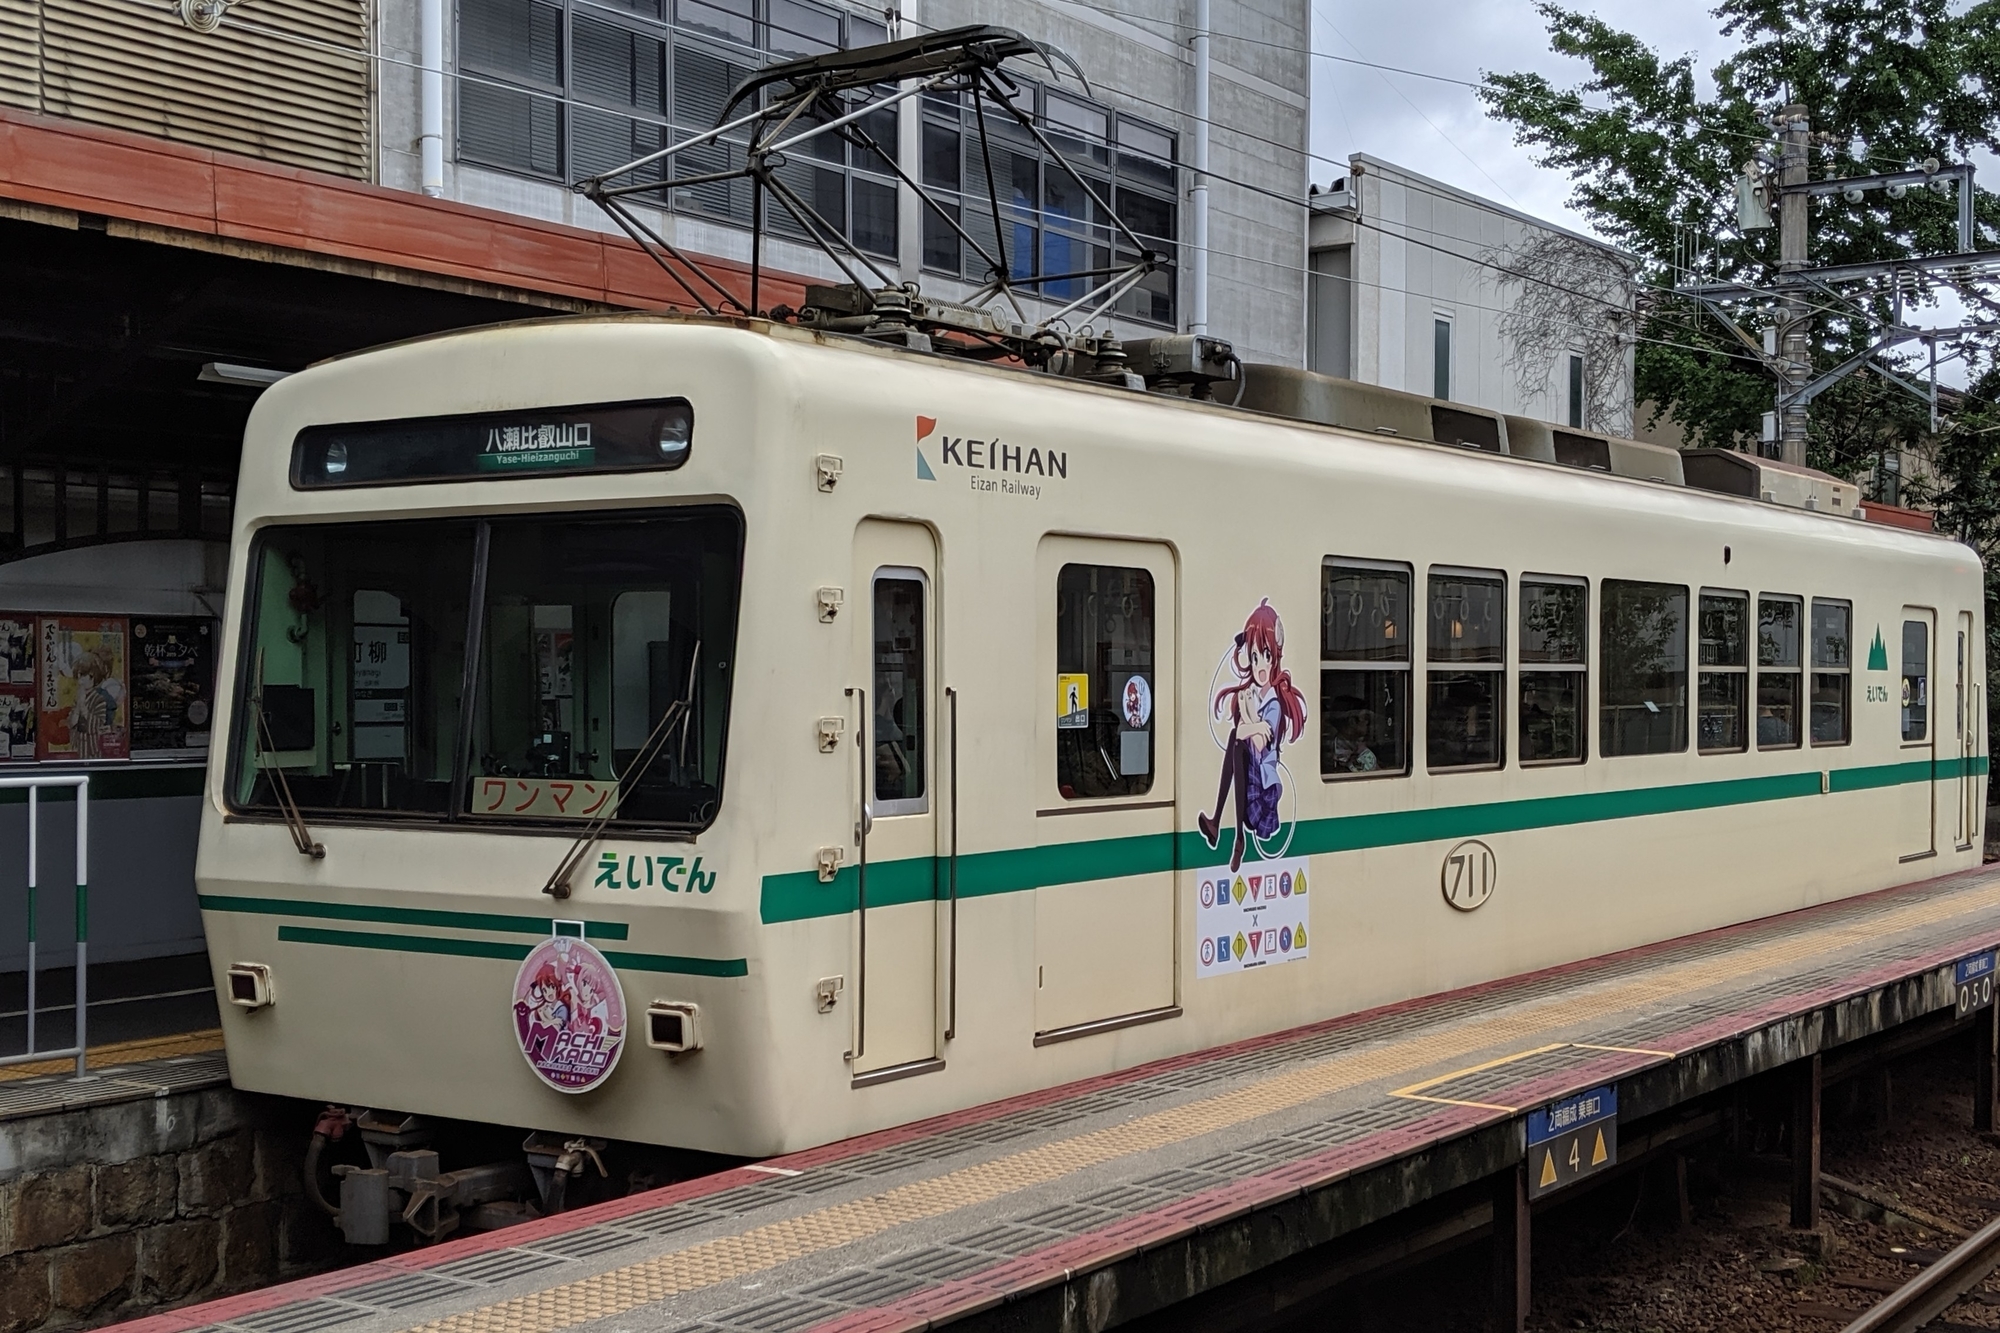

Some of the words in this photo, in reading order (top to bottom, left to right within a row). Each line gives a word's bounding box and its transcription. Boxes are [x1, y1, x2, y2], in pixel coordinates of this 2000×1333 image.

[485, 423, 592, 451] 八瀬比叡山口
[496, 450, 580, 465] Yase-Hieizanguchi
[942, 436, 1067, 479] KEIHAN
[970, 475, 998, 492] Eizan
[1001, 479, 1041, 500] Railway
[1866, 685, 1889, 703] えいでん
[483, 780, 608, 815] ワンマン
[594, 852, 717, 894] えいでん
[1449, 851, 1488, 900] 711
[1960, 977, 1991, 1013] 050
[551, 1048, 609, 1067] KADO
[1578, 1096, 1601, 1120] 乗車口
[1568, 1138, 1580, 1173] 4
